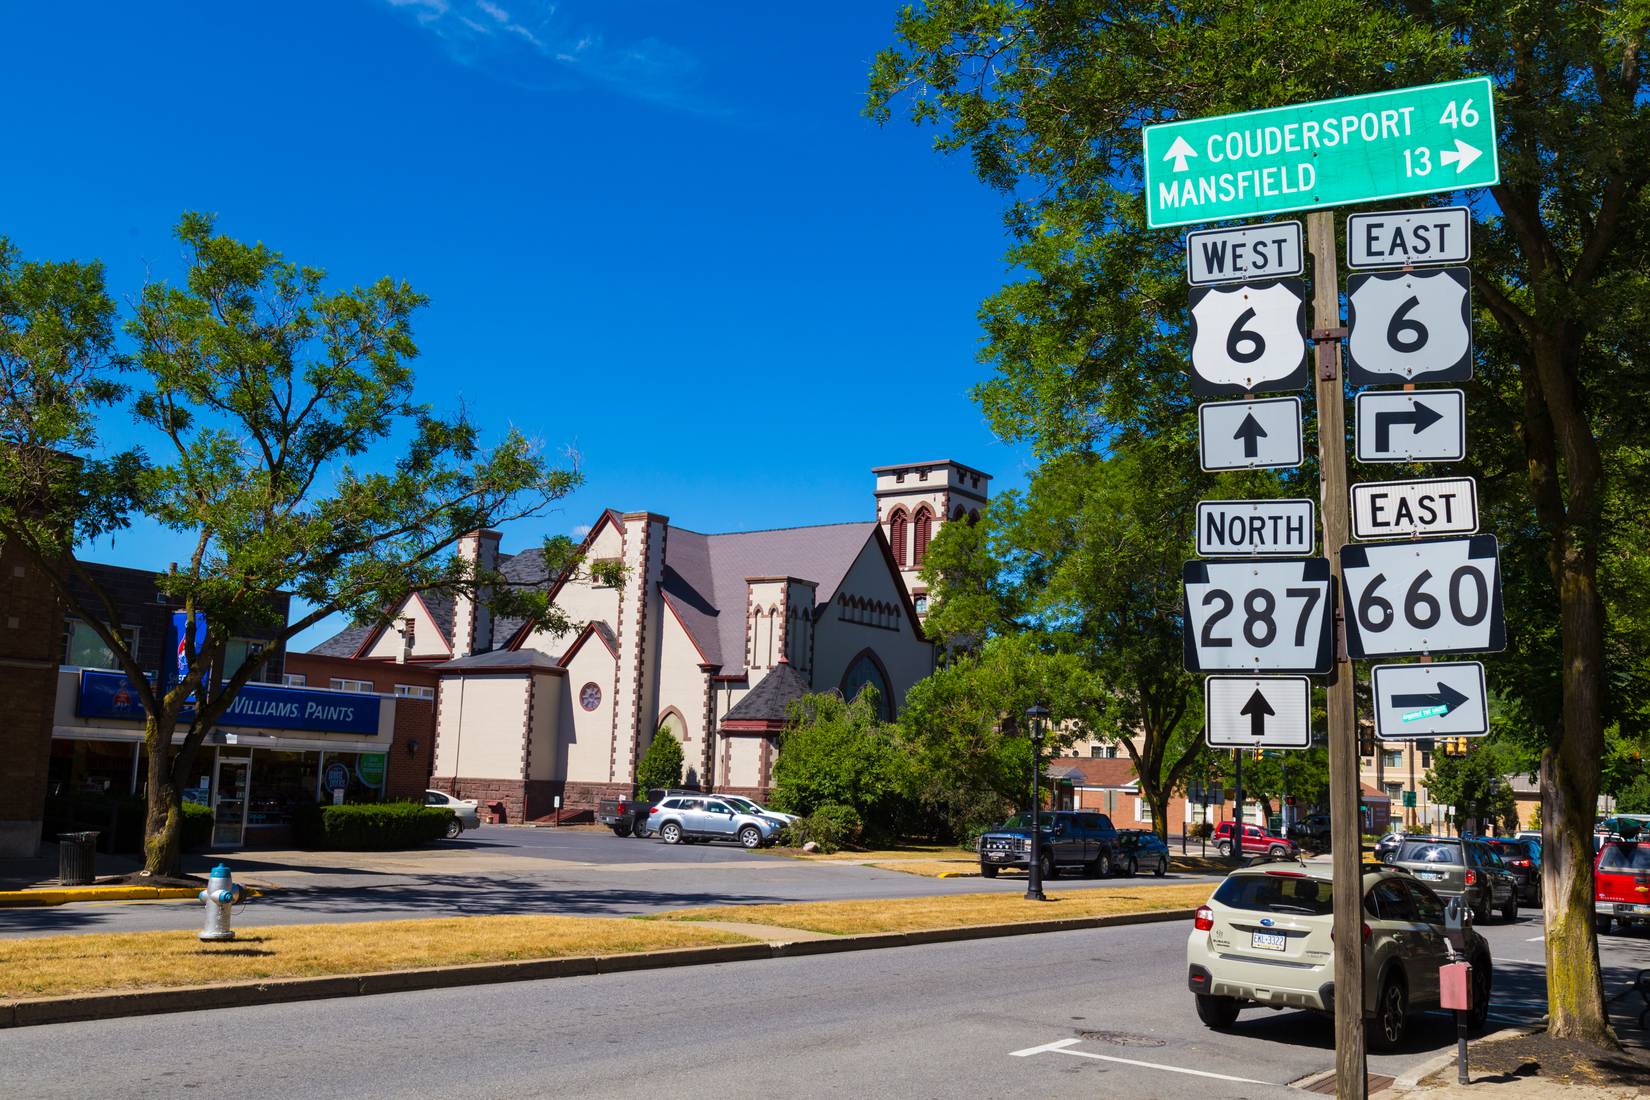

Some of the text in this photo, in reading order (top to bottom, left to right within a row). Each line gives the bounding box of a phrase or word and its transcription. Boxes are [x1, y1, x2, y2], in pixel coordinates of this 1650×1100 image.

[1207, 98, 1480, 163] COUDERSPORT 46
[1158, 147, 1432, 210] MANSFIELD 13
[1202, 239, 1288, 275] WEST
[1366, 223, 1451, 257] EAST
[1226, 306, 1266, 364] 6
[1387, 295, 1429, 353] 6
[1206, 512, 1304, 546] NORTH
[1370, 493, 1457, 527] EAST
[1201, 588, 1321, 648] 287
[1358, 565, 1489, 633] 660
[305, 702, 355, 722] PAINTS
